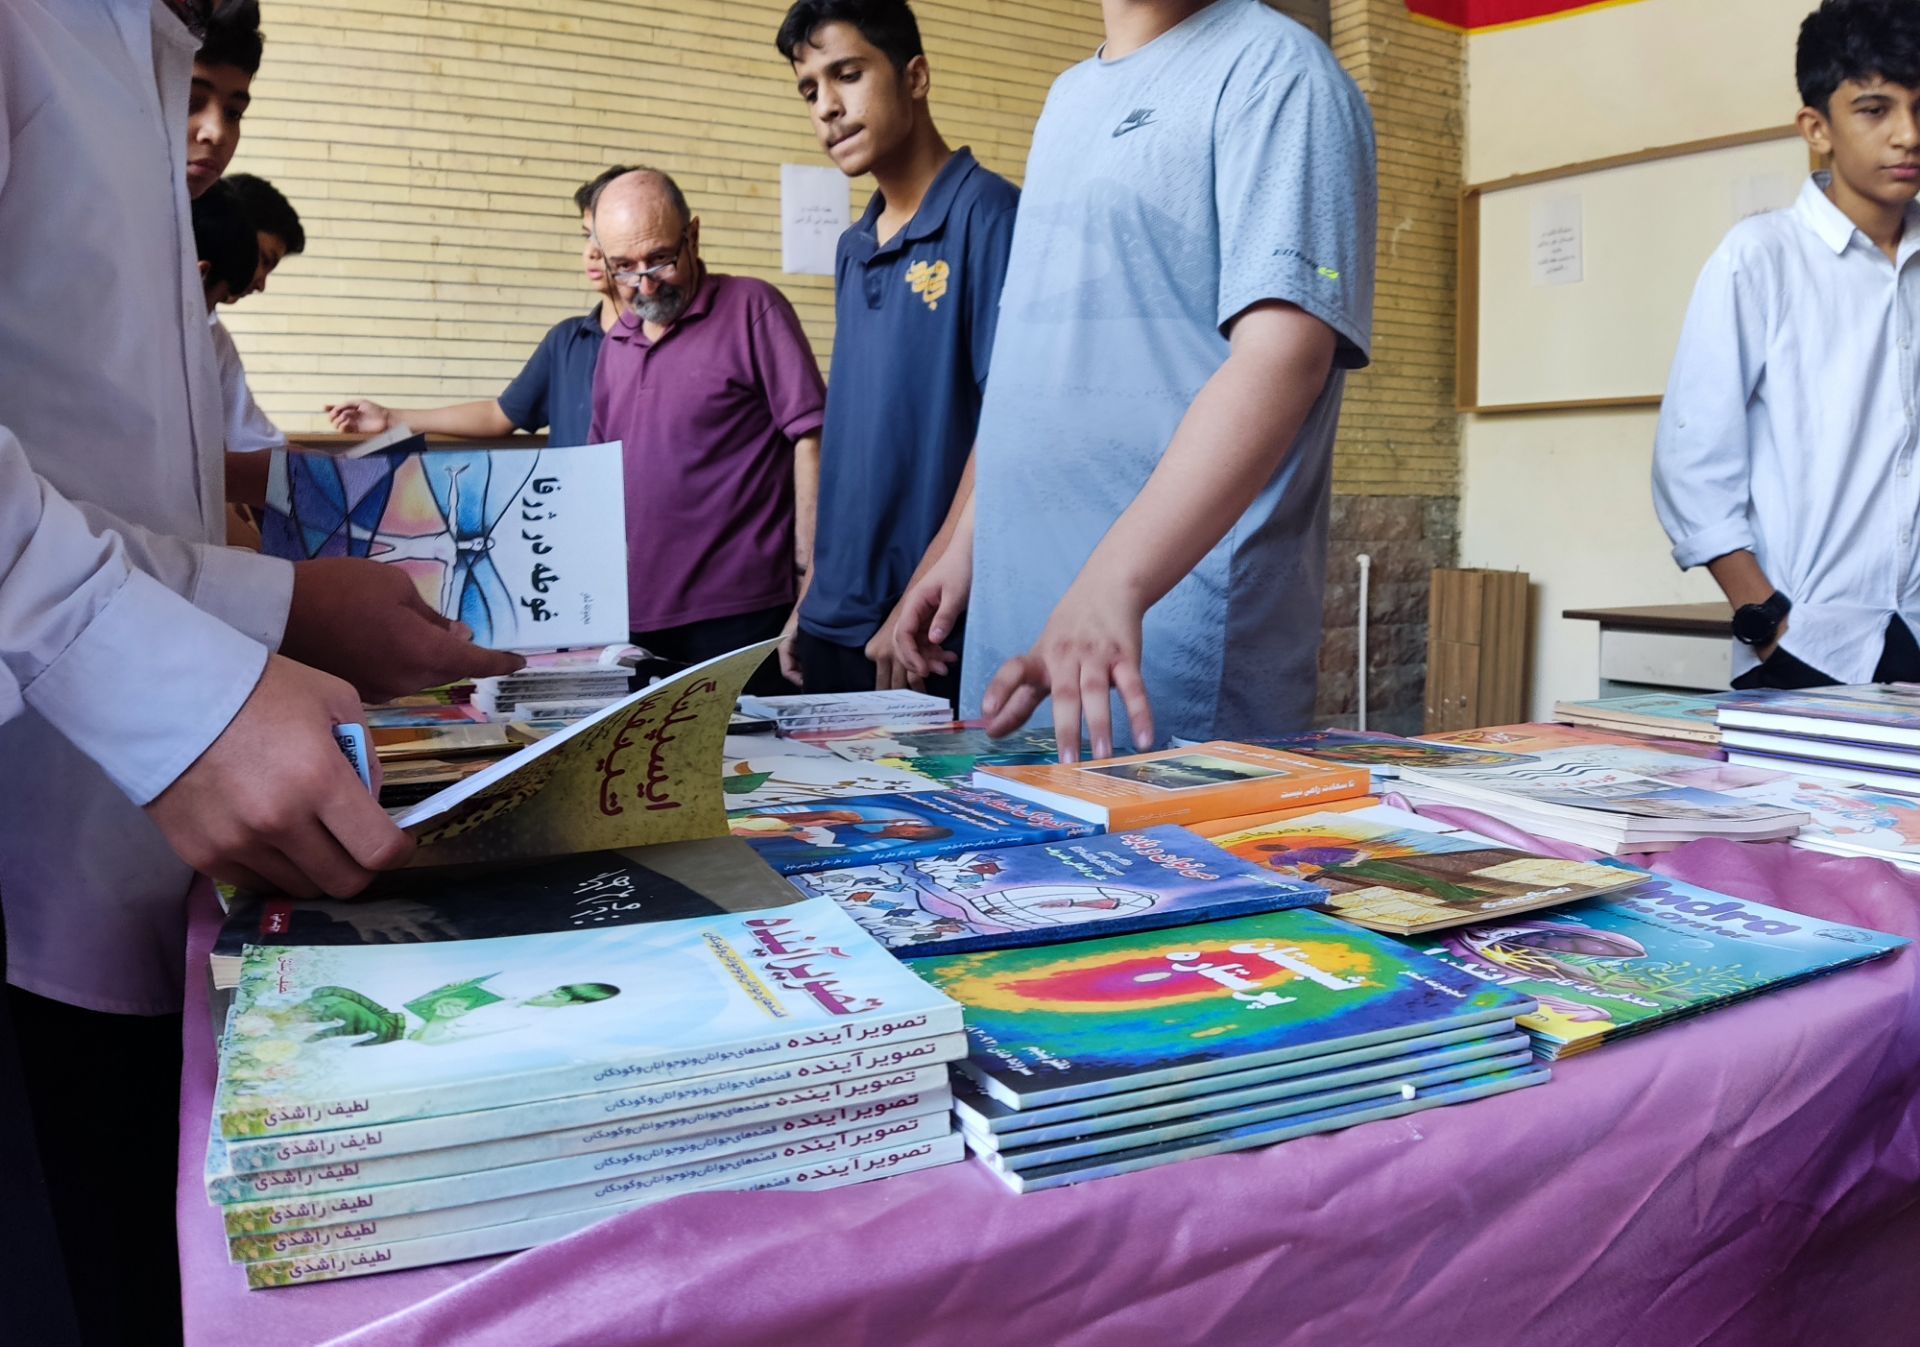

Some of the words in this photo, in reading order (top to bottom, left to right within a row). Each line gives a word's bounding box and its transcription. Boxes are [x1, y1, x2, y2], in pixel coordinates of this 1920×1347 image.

[521, 476, 562, 521] ژرفا
[521, 528, 553, 555] در
[520, 562, 560, 622] غوطه
[1655, 911, 1752, 939] Oyster
[741, 917, 851, 961] آینده
[1228, 942, 1366, 991] شبستان
[763, 961, 886, 1016] تصویر
[787, 1023, 855, 1049] آینده
[857, 1014, 928, 1041] تصویر
[797, 1052, 864, 1078] آینده
[865, 1042, 937, 1070] تصویر
[775, 1081, 843, 1106] آینده
[844, 1071, 916, 1098] تصویر
[263, 1105, 322, 1127] راشدی
[327, 1099, 370, 1119] لطیف
[849, 1094, 919, 1122] تصویر
[340, 1130, 383, 1150] لطیف
[783, 1132, 849, 1157] آینده
[850, 1118, 919, 1147] تصویر
[276, 1138, 335, 1161] راشدی
[862, 1143, 932, 1172] تصویر
[254, 1168, 313, 1191] راشدی
[317, 1162, 360, 1182] لطیف
[796, 1157, 861, 1183] آینده
[268, 1203, 327, 1225] راشدی
[331, 1193, 374, 1213] لطیف
[272, 1230, 331, 1252] راشدی
[335, 1221, 377, 1241] لطیف
[288, 1257, 346, 1279] راشدی
[350, 1248, 392, 1268] لطیف
